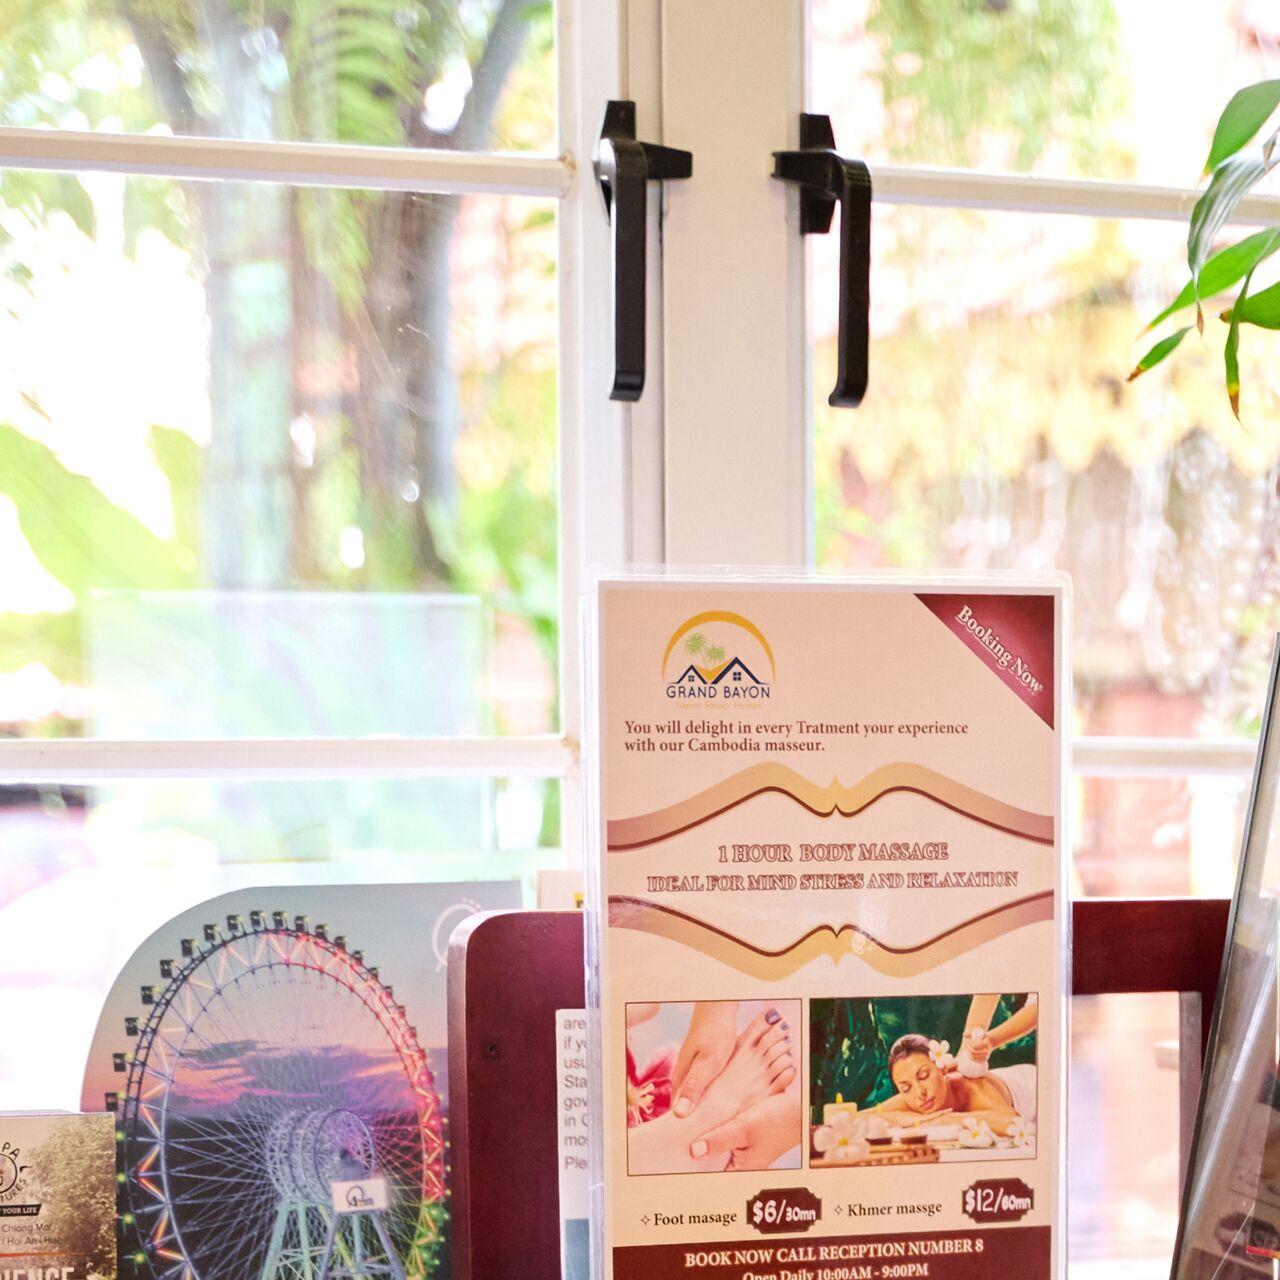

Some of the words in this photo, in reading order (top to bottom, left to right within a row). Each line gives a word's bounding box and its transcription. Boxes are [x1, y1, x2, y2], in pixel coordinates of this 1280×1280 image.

[956, 604, 1014, 668] Booking
[1007, 656, 1044, 692] Now
[666, 685, 717, 699] GRAND
[724, 684, 771, 698] BAYON
[624, 720, 652, 735] You
[655, 720, 681, 735] will
[684, 719, 734, 740] delight
[738, 721, 752, 735] in
[756, 724, 793, 740] every
[796, 720, 860, 735] Tratment
[863, 724, 894, 740] your
[898, 721, 969, 740] experience
[624, 737, 656, 752] with
[659, 741, 684, 752] our
[688, 737, 761, 752] Cambodia
[764, 741, 825, 752] masseur.
[719, 844, 729, 862] 1
[732, 844, 794, 862] HOUR
[799, 843, 857, 861] BODY
[859, 842, 950, 861] MASSAGE
[647, 875, 705, 892] IDEAL
[707, 874, 746, 891] FOR
[748, 873, 797, 890] MIND
[799, 873, 865, 889] STRESS
[866, 872, 905, 889] AND
[907, 870, 1020, 888] RELAXATION
[654, 1210, 685, 1226] Foot
[687, 1211, 738, 1229] masage
[847, 1202, 893, 1217] Khmer
[896, 1201, 943, 1219] massge
[685, 1249, 732, 1267] BOOK
[735, 1248, 774, 1265] NOW
[776, 1246, 816, 1263] CALL
[819, 1242, 906, 1261] RECEPTION
[908, 1240, 972, 1257] NUMBER
[974, 1238, 985, 1253] 8
[882, 1262, 929, 1279] 9:00PM
